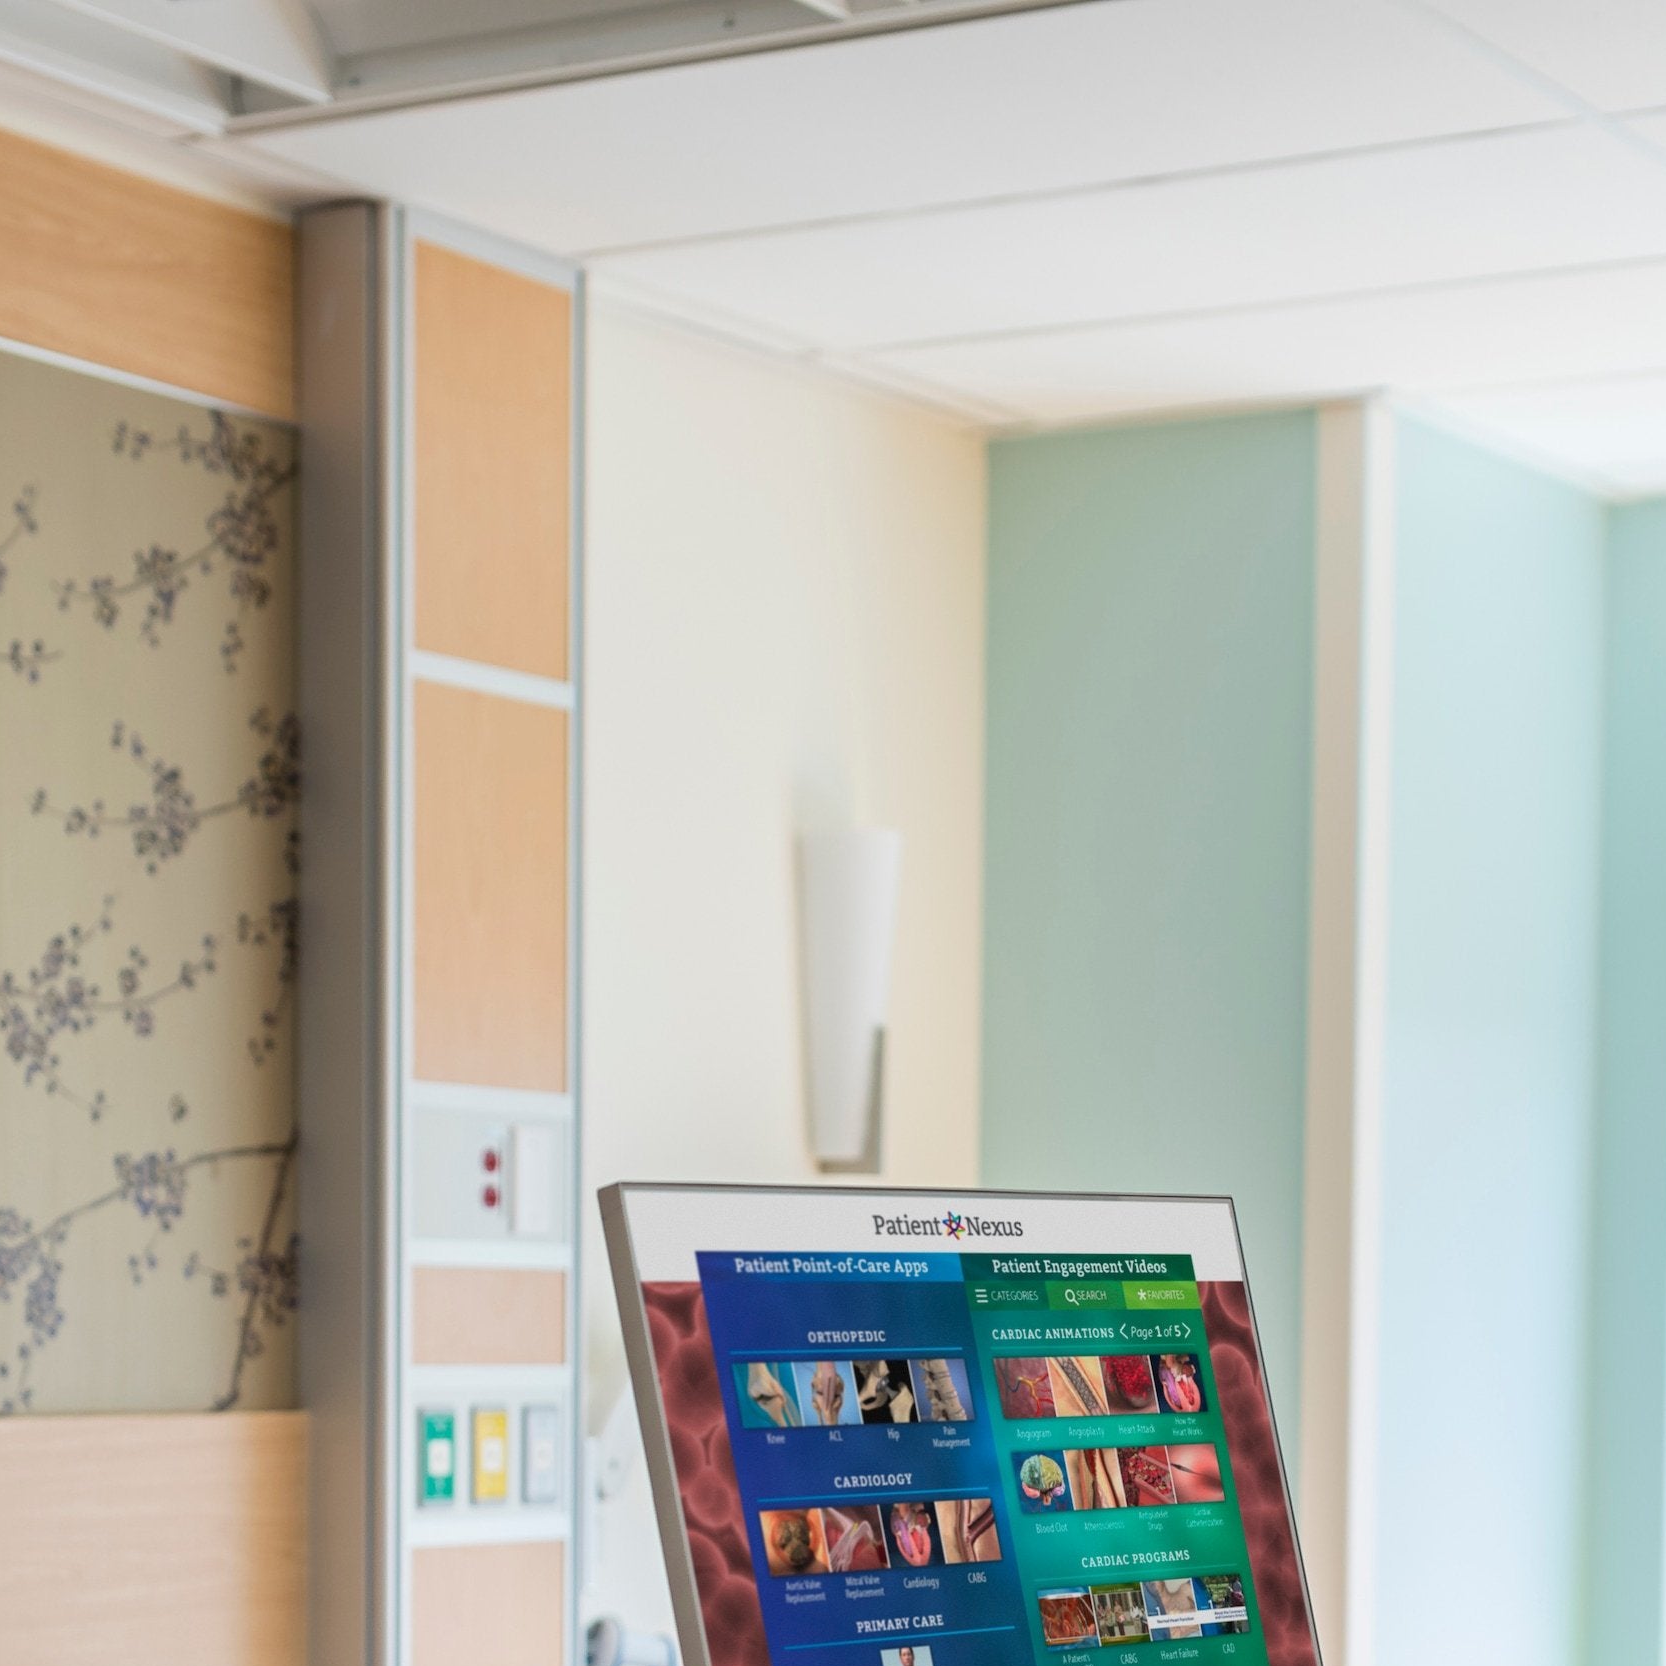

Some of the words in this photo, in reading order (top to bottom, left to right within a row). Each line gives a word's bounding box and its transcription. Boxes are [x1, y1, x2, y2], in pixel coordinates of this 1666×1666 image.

[872, 1214, 942, 1236] Patient
[965, 1216, 1023, 1237] Nexus
[734, 1257, 790, 1274] Patient
[793, 1257, 890, 1274] Point-of-Care
[894, 1259, 928, 1277] Apps
[992, 1258, 1041, 1274] Patient
[1044, 1259, 1124, 1277] Engagement
[1125, 1259, 1167, 1274] Videos
[990, 1290, 1039, 1301] CATEGORIES
[1076, 1290, 1107, 1301] SEARCH
[1148, 1289, 1185, 1300] FAVORITES
[807, 1331, 886, 1344] ORTHOPEDIC
[992, 1328, 1042, 1340] CARDIAC
[1045, 1327, 1115, 1339] ANIMATIONS
[1130, 1326, 1153, 1342] Page
[1155, 1325, 1162, 1338] 1
[1163, 1324, 1174, 1338] of
[1174, 1324, 1181, 1338] 5
[828, 1430, 844, 1442] ACL
[886, 1428, 900, 1442] Hip
[942, 1425, 957, 1436] Pain
[1016, 1428, 1052, 1442] Angiogram
[1118, 1425, 1135, 1435] Heart
[1136, 1424, 1156, 1434] Attack
[765, 1432, 786, 1445] Knee
[932, 1437, 971, 1449] Management
[833, 1472, 913, 1489] CARDIOLOGY
[1081, 1553, 1130, 1568] CARDIAC
[1132, 1549, 1191, 1565] PROGRAMS
[903, 1576, 940, 1590] Cardiology
[967, 1571, 987, 1585] CABG
[785, 1592, 827, 1604] Replacement
[845, 1587, 885, 1600] Replacement
[856, 1617, 910, 1634] PRIMARY
[912, 1614, 944, 1629] CARE
[1160, 1650, 1179, 1661] Heart
[1179, 1648, 1199, 1660] Failure
[1222, 1643, 1236, 1655] CAD
[1120, 1653, 1139, 1665] CABG
